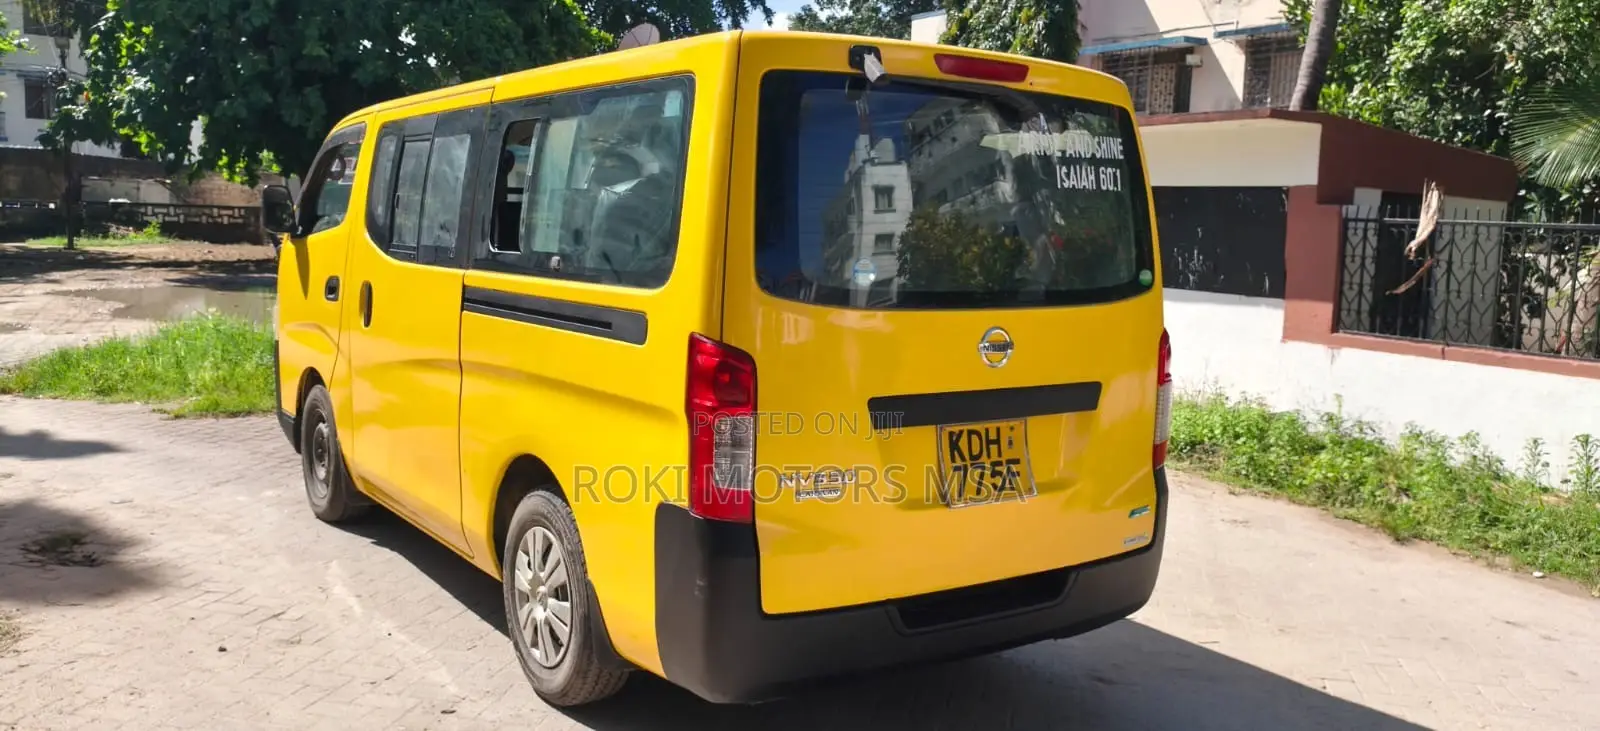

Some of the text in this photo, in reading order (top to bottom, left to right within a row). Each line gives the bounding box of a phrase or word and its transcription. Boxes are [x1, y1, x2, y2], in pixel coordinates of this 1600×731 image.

[1065, 133, 1092, 159] AND
[1094, 136, 1124, 160] SHINE
[1056, 165, 1121, 192] ISAIAH 60:1
[948, 427, 1002, 463] KDH
